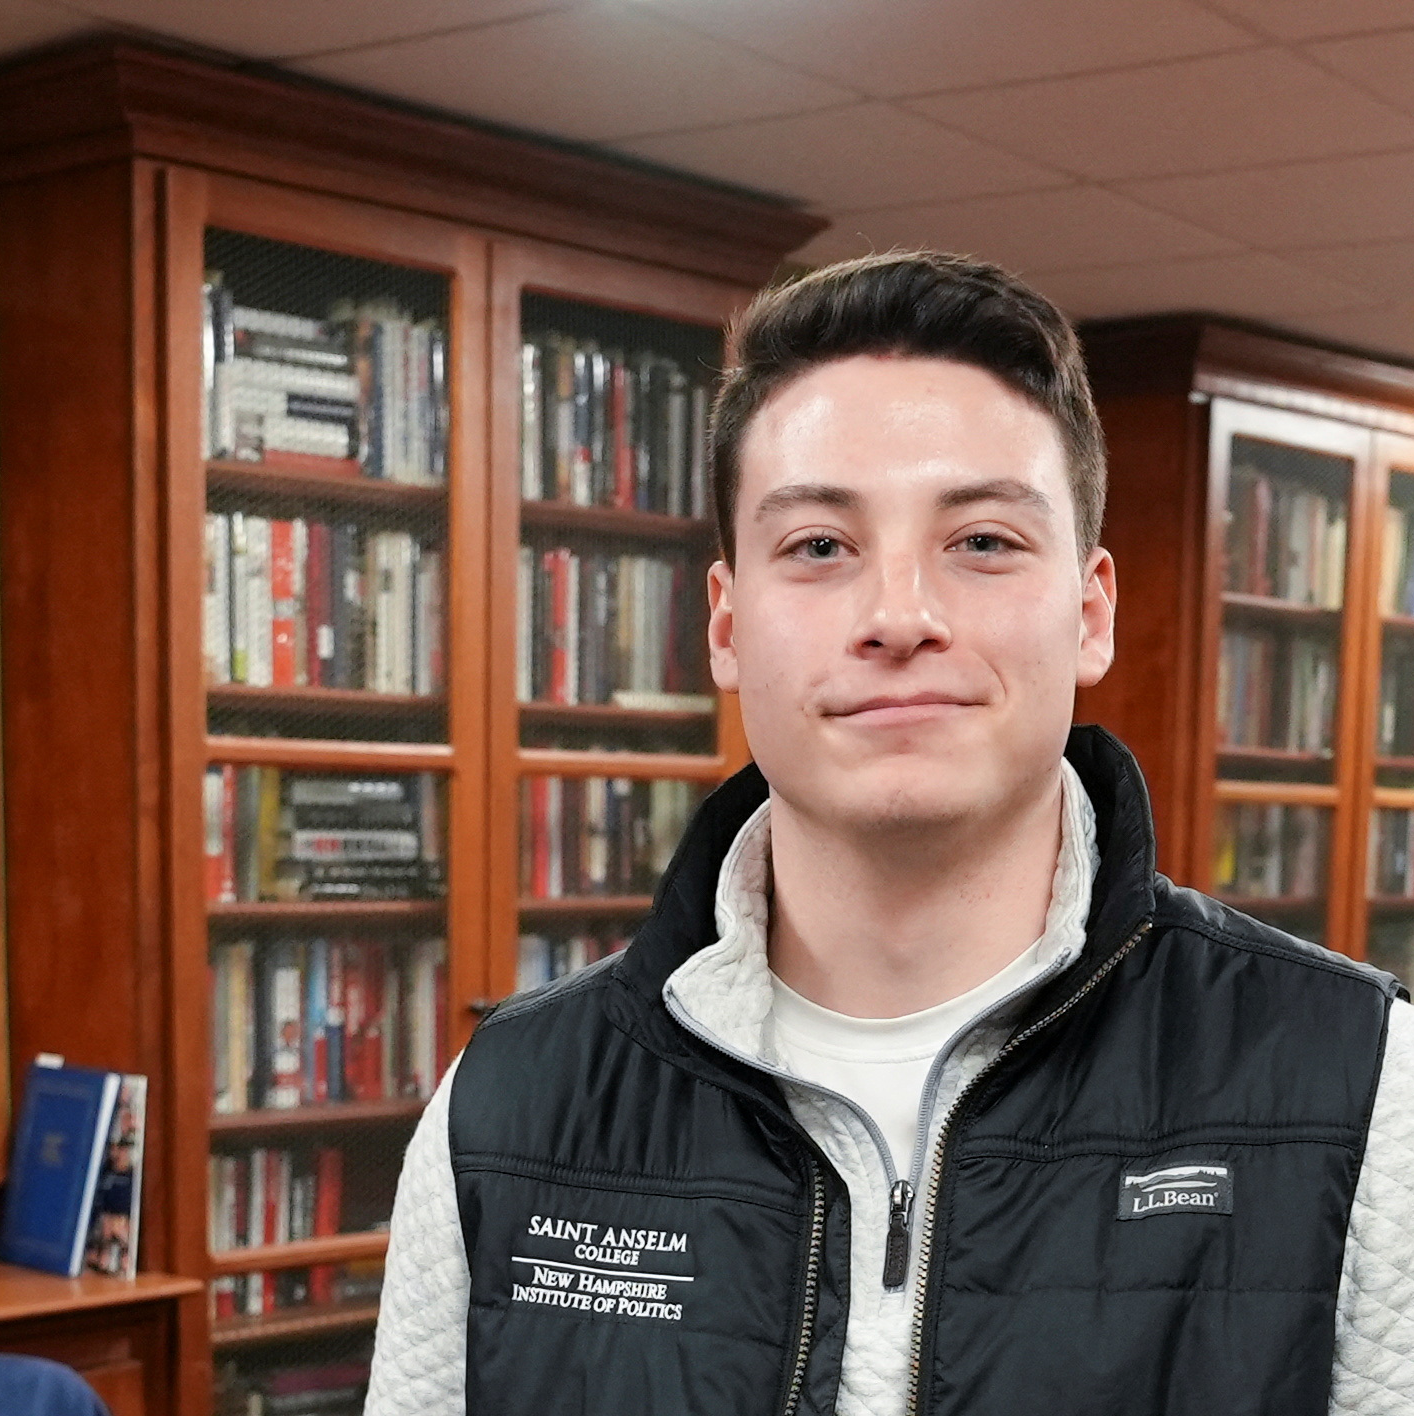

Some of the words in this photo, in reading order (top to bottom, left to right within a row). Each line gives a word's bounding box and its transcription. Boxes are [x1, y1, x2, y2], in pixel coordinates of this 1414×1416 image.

[1132, 1190, 1215, 1213] L.L.Bean
[528, 1215, 598, 1244] SAINT
[600, 1226, 688, 1253] ANSELM
[574, 1244, 640, 1266] COLLEGE
[532, 1265, 575, 1289] NEW
[578, 1272, 668, 1300] HAMPSHIRE
[511, 1283, 593, 1311] INSTITUTE
[593, 1296, 617, 1314] OF
[616, 1297, 683, 1321] POLITICS
